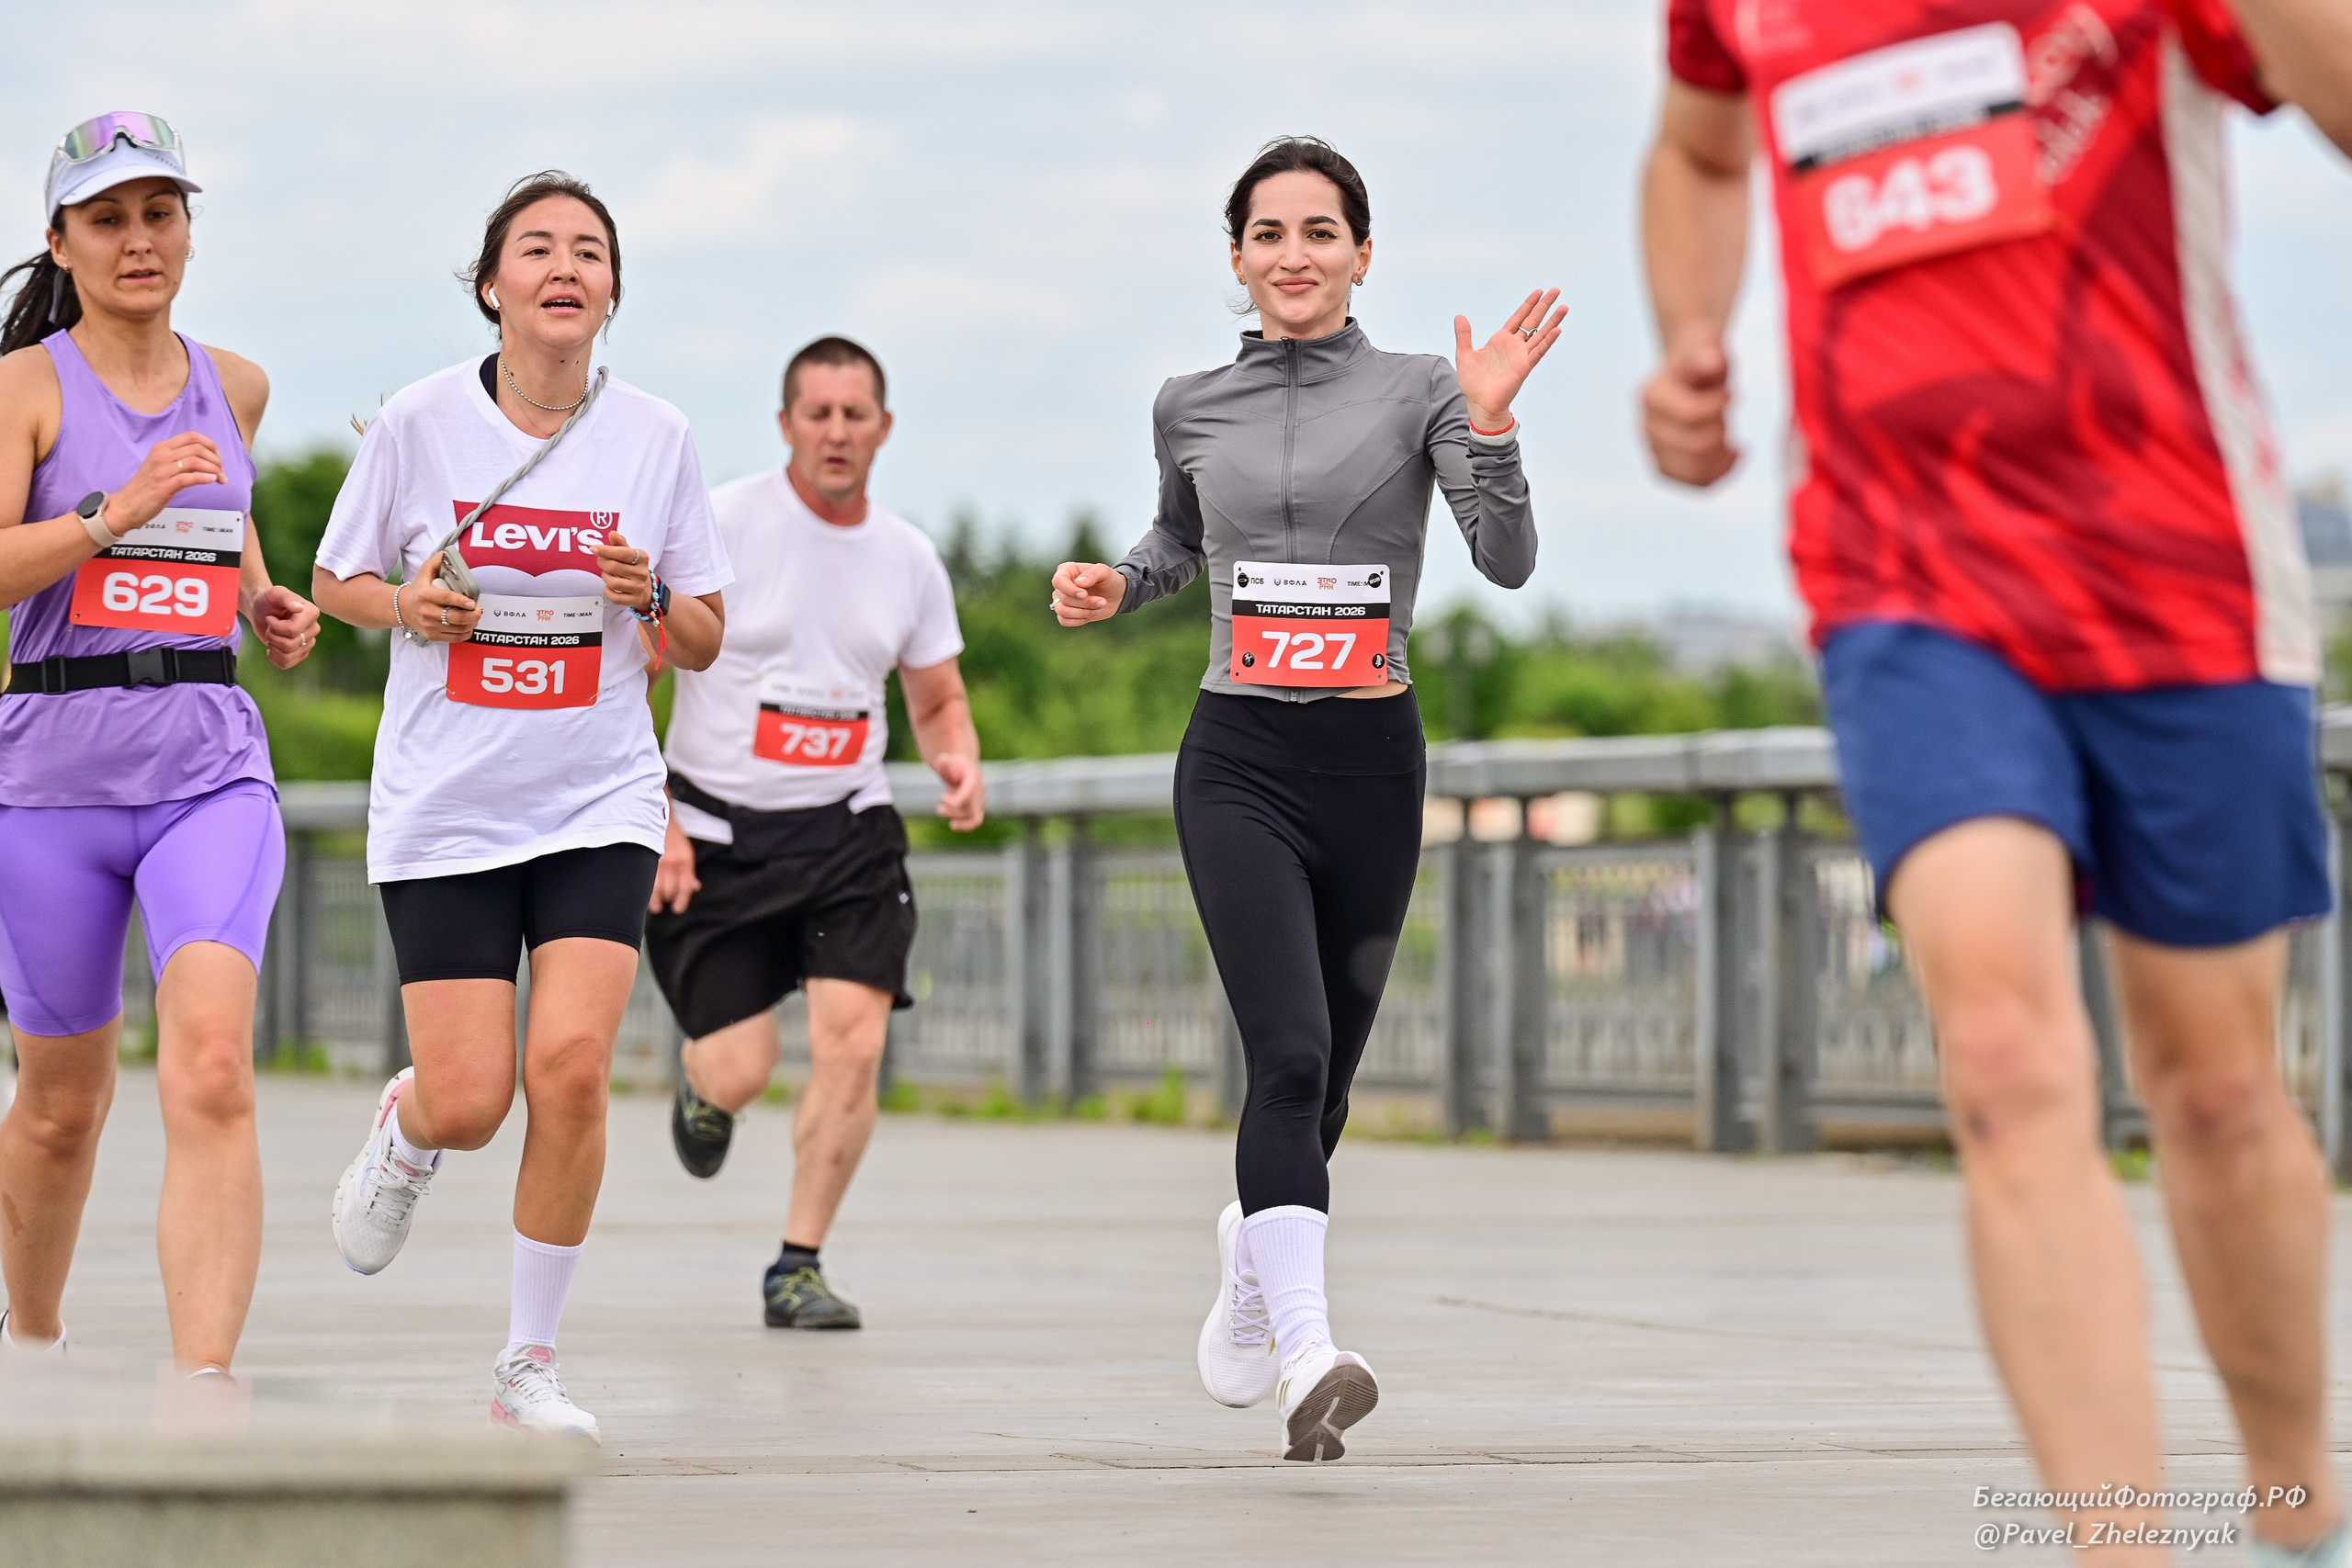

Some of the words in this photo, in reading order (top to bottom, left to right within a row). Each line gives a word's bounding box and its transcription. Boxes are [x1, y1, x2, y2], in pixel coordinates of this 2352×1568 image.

[1822, 144, 1998, 253] 643
[109, 547, 183, 559] ТАТАРСТАН
[184, 550, 217, 562] 2026
[102, 571, 209, 617] 629
[1255, 604, 1331, 616] ТАТАРСТАН
[1334, 606, 1366, 616] 2026
[474, 631, 548, 646] ТАТАРСТАН
[551, 636, 580, 646] 2026
[1261, 630, 1357, 670] 727
[481, 657, 566, 694] 531
[780, 722, 852, 760] 737
